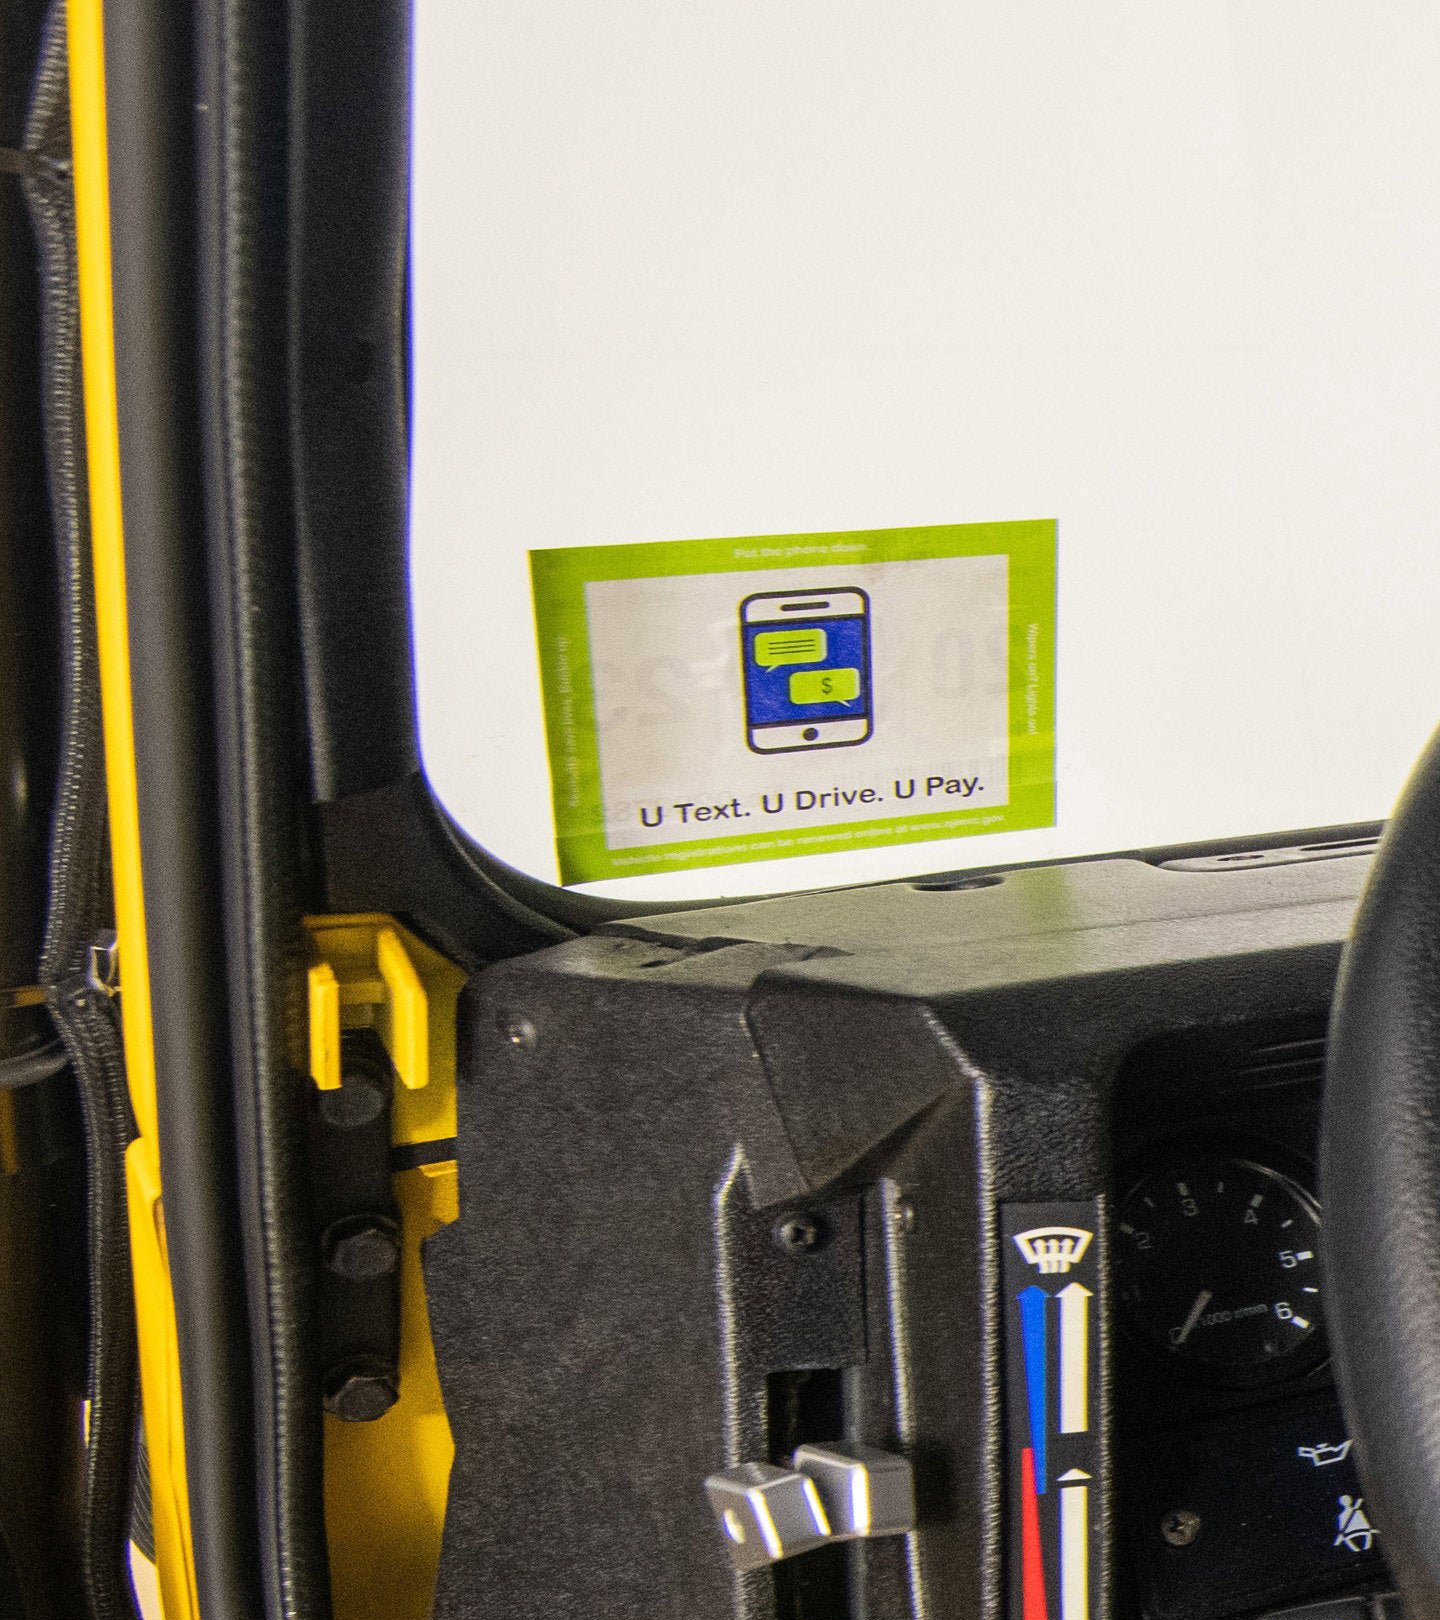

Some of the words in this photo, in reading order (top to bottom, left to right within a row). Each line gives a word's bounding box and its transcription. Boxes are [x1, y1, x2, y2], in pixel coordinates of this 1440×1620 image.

[640, 805, 663, 828] U
[674, 799, 751, 823] Text.
[762, 792, 784, 814] U
[795, 787, 883, 811] Drive.
[895, 778, 916, 800] U
[926, 775, 985, 797] Pay.
[1181, 1198, 1200, 1217] 3
[1244, 1209, 1259, 1225] 4
[1135, 1231, 1153, 1250] 2
[1278, 1250, 1297, 1269] 5
[1274, 1301, 1293, 1320] 6
